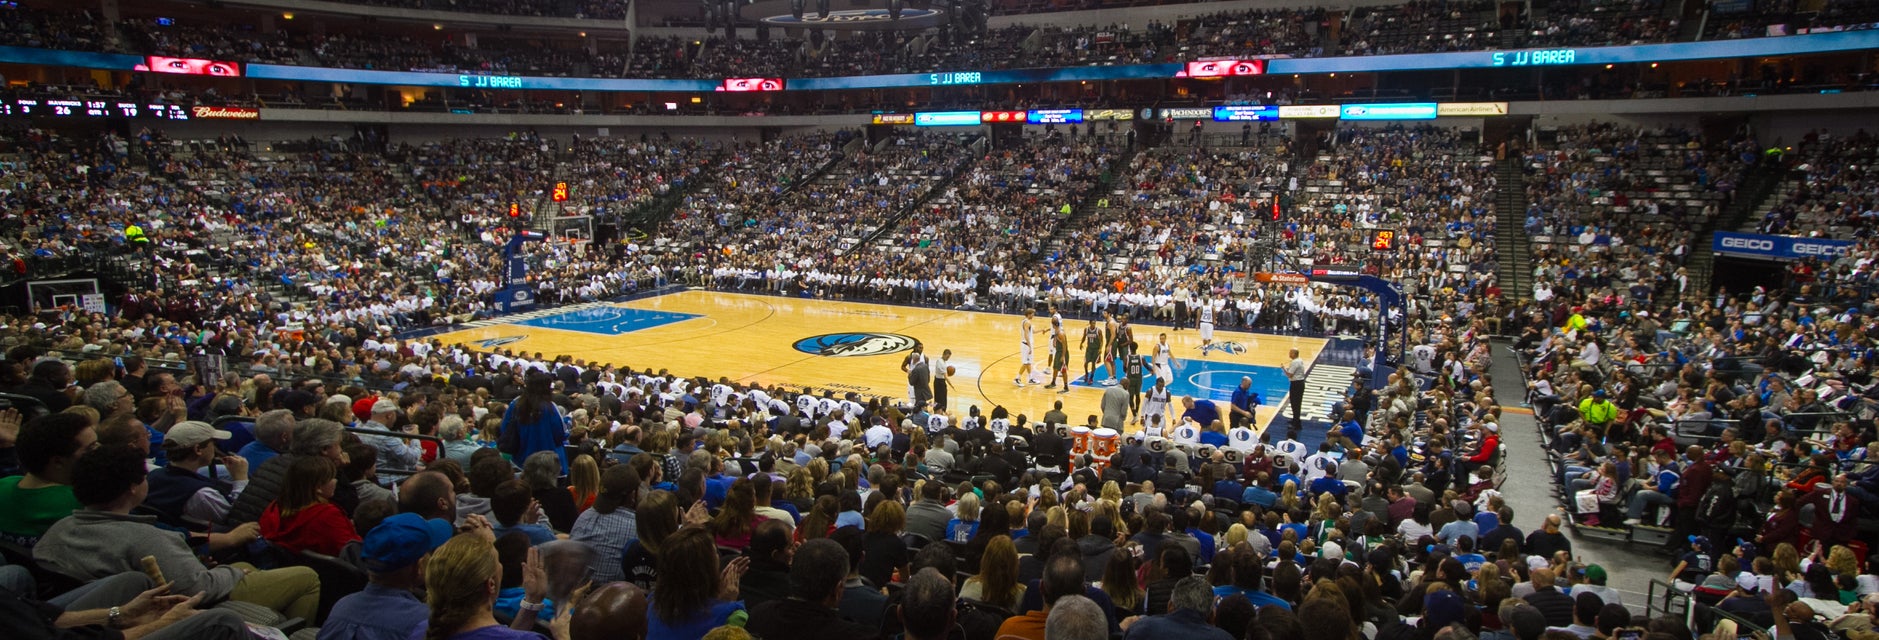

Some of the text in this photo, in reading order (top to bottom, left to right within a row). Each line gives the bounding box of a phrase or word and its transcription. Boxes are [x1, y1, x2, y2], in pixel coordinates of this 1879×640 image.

[1511, 51, 1529, 66] JJ
[1531, 49, 1576, 65] BAREA
[475, 75, 488, 87] JJ
[490, 75, 521, 88] BAREA
[942, 73, 953, 84] JJ
[954, 72, 981, 84] BAREA
[55, 106, 72, 116] 26
[123, 108, 138, 117] 19
[192, 106, 258, 118] Budweiser
[1170, 108, 1212, 116] BACHENDORF'S
[554, 188, 567, 200] 24
[1376, 237, 1390, 248] 24
[1721, 236, 1774, 251] GEICO
[1130, 365, 1140, 375] 00
[1057, 426, 1068, 437] G
[1150, 440, 1163, 452] G
[1198, 447, 1210, 458] G
[1224, 450, 1236, 461] G
[1273, 455, 1285, 467] G
